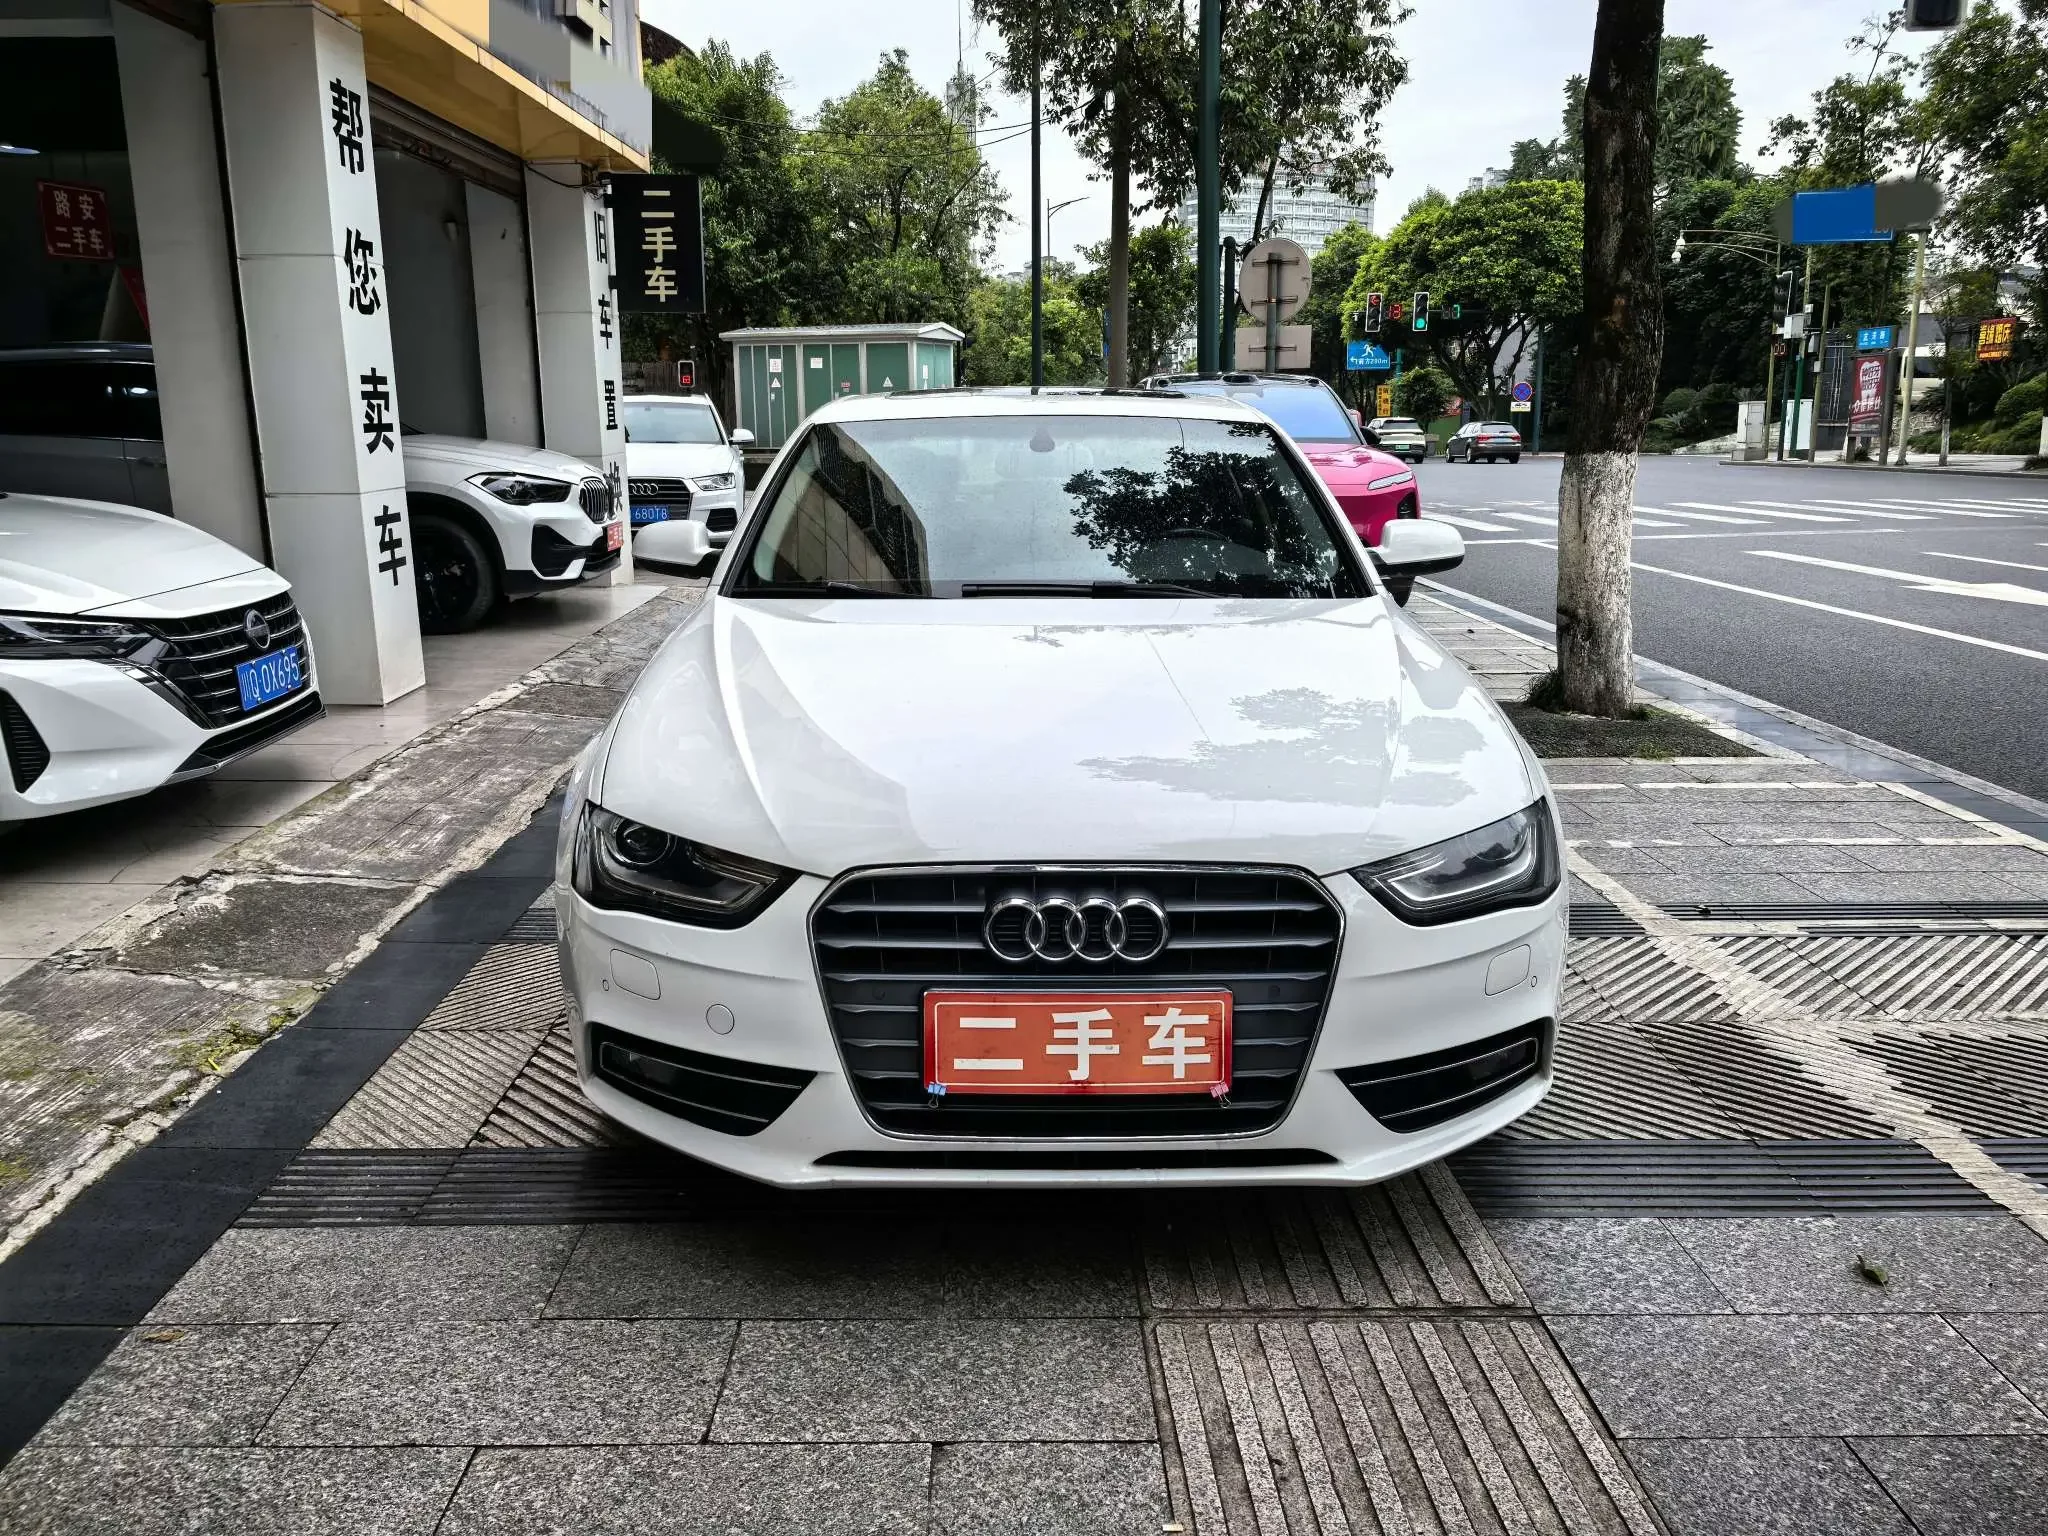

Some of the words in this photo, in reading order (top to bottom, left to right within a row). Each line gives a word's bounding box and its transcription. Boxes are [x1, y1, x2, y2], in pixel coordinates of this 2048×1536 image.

[53, 190, 97, 220] 路安
[55, 226, 105, 254] 二手车
[640, 190, 679, 303] 二手车
[329, 77, 407, 587] 帮您卖车
[953, 1006, 1212, 1081] 二手车
